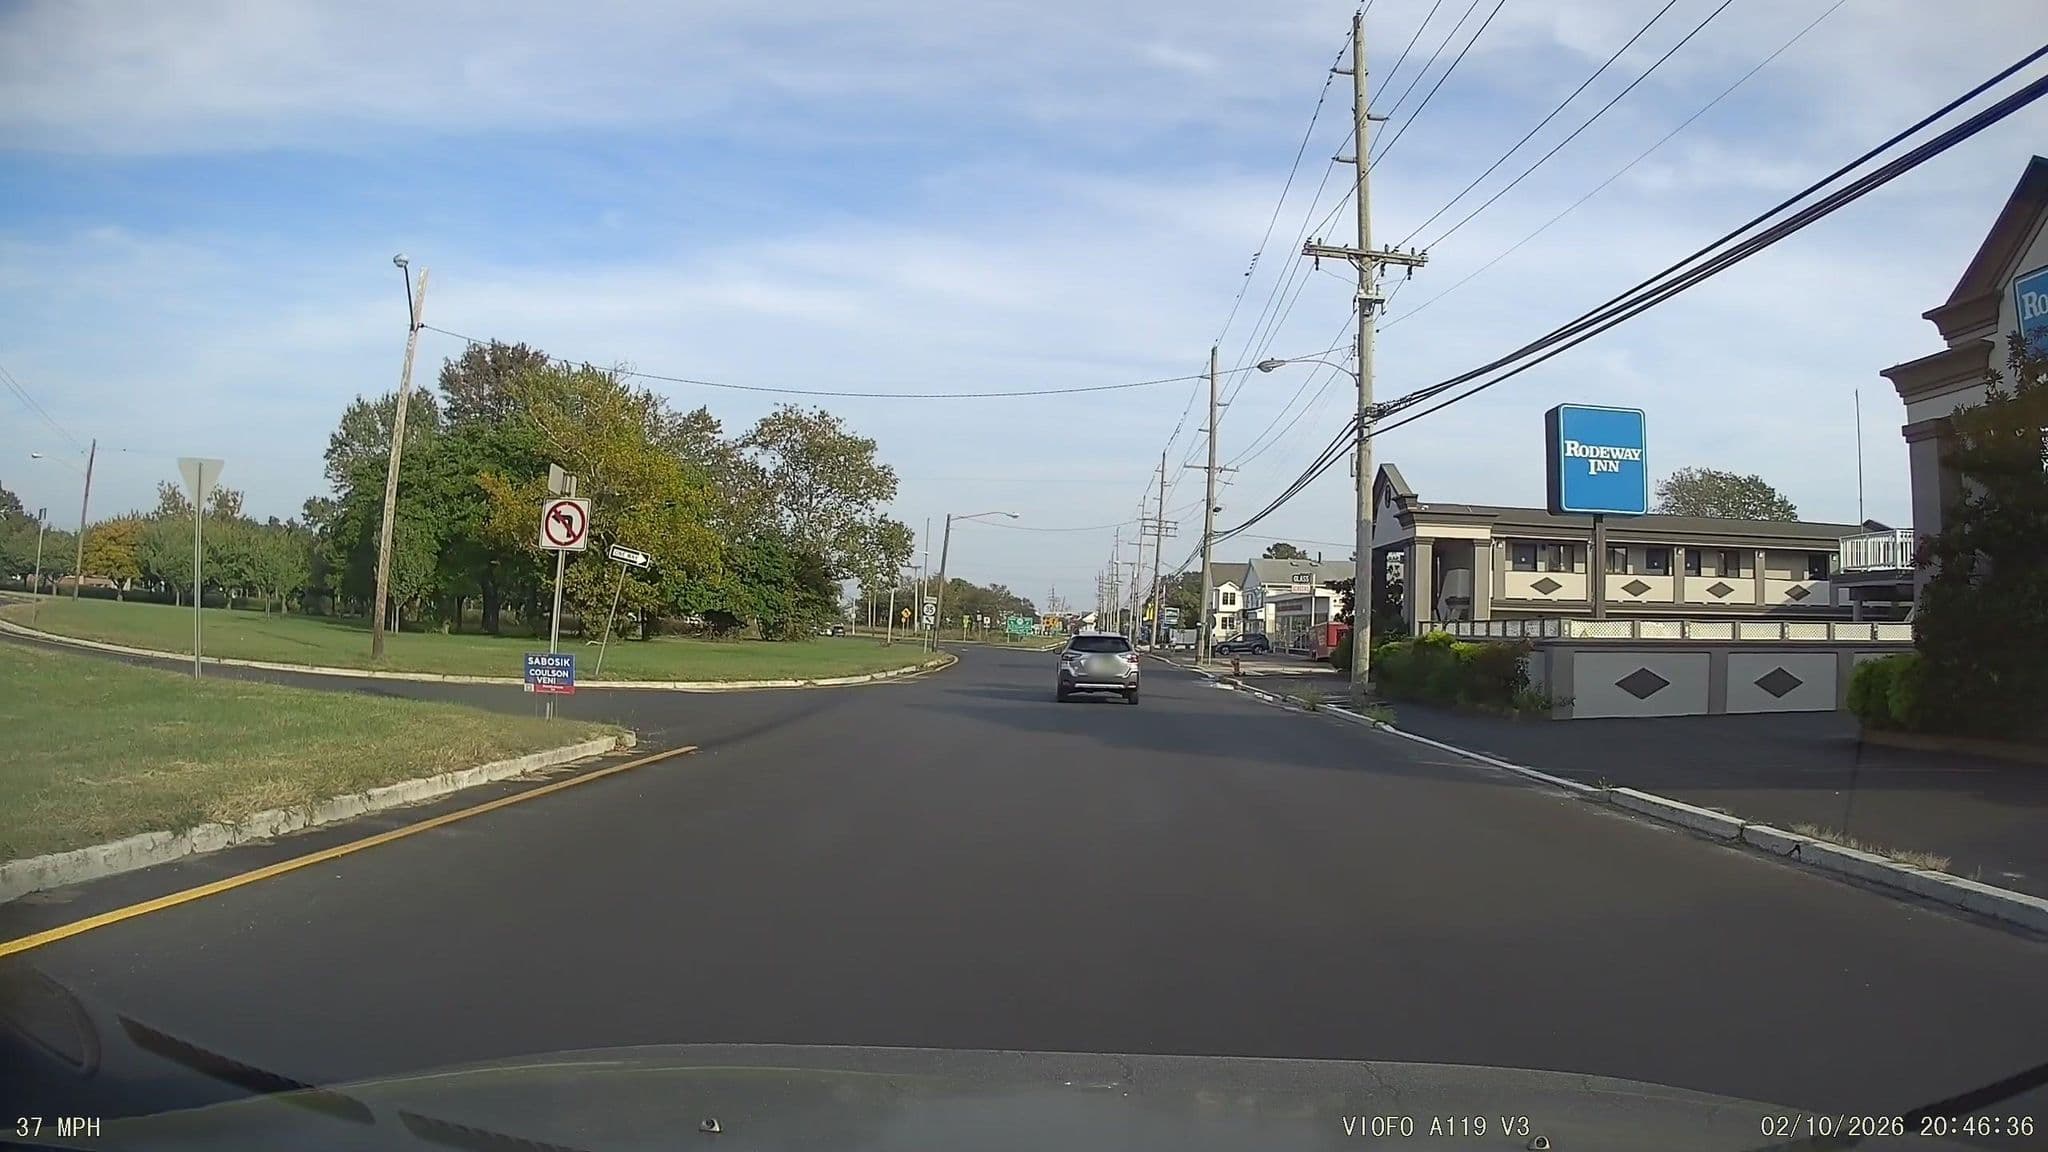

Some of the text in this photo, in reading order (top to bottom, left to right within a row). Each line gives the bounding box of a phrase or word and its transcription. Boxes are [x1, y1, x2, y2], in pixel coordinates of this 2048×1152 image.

[1565, 440, 1642, 460] RODEWAY
[1588, 459, 1620, 475] INN
[925, 605, 934, 614] 35
[528, 656, 571, 667] SABOSIK
[529, 668, 570, 678] COULSON
[536, 676, 557, 684] VENI
